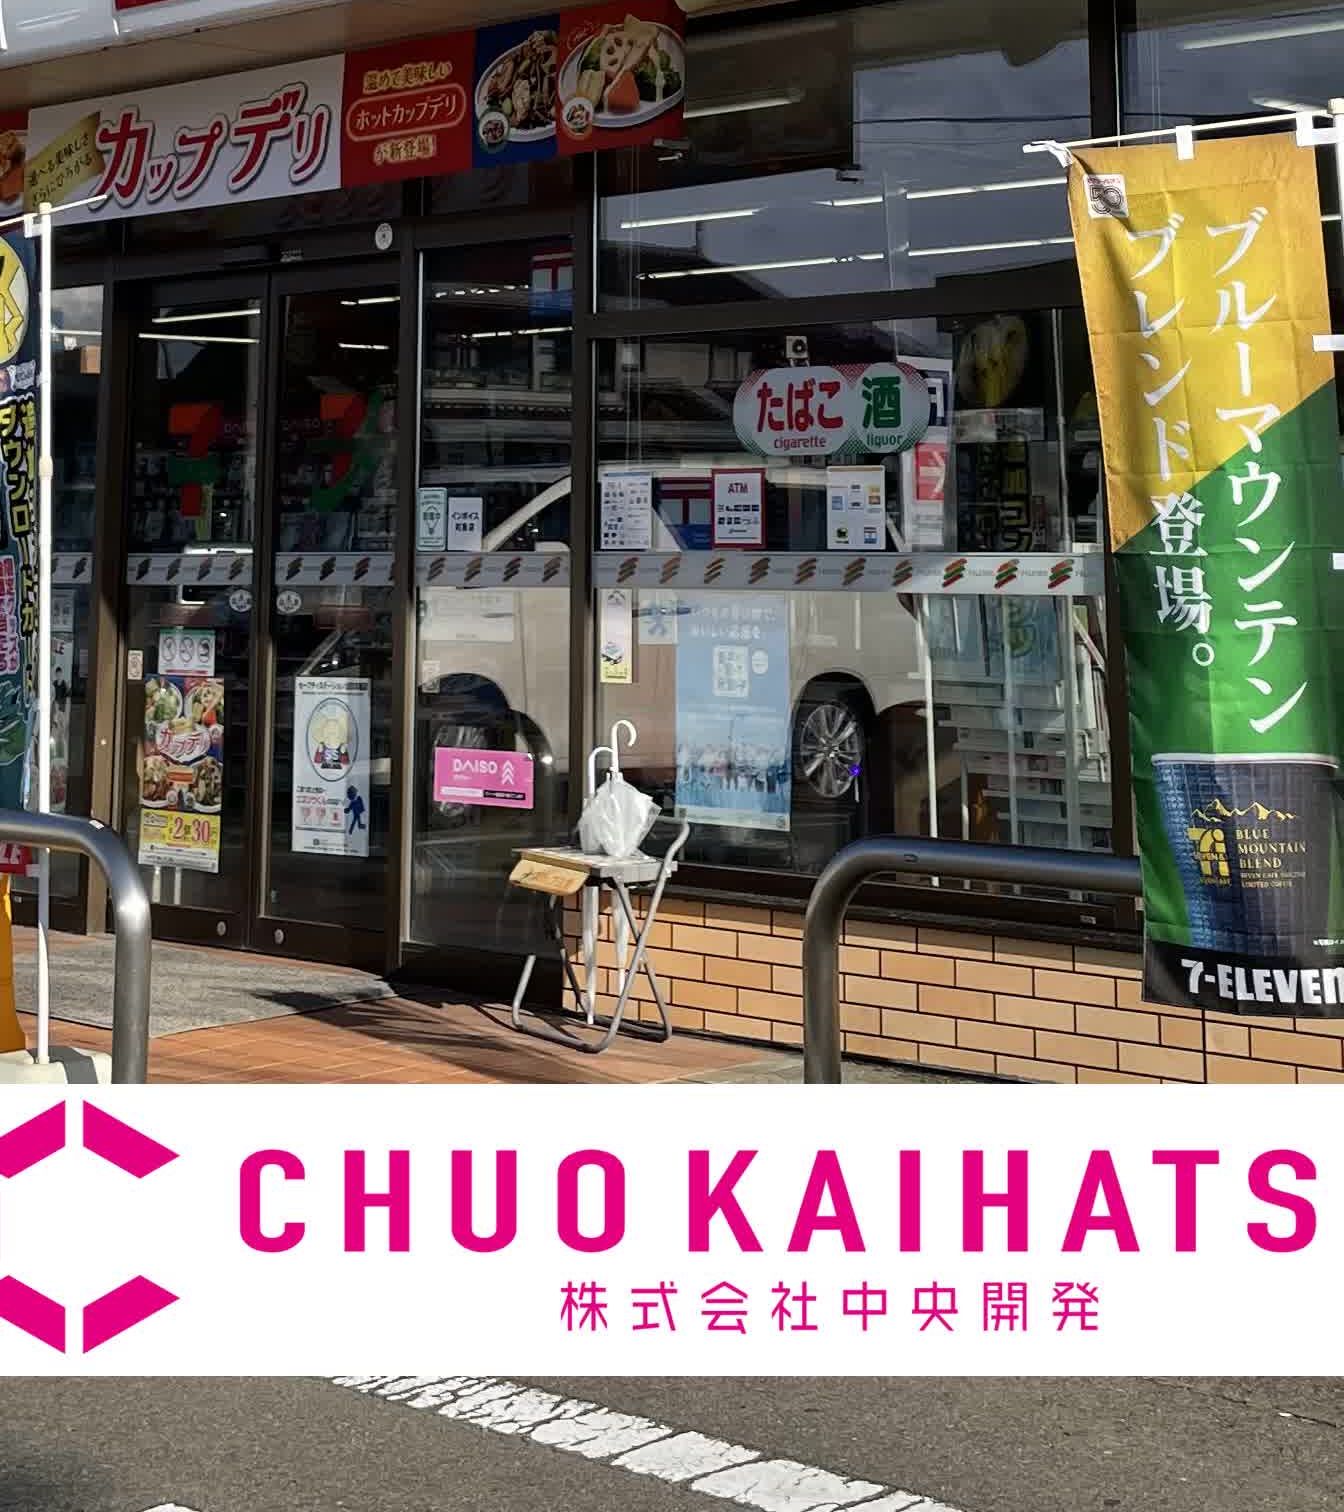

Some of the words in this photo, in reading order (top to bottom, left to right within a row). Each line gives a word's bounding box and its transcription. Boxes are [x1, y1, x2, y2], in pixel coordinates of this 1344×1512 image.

[356, 93, 457, 130] ホットカップデリ
[93, 85, 327, 204] カップデリ
[757, 377, 844, 432] たばこ
[862, 376, 902, 428] 酒
[773, 436, 827, 451] cigarette
[867, 433, 904, 447] liquor
[1126, 213, 1216, 668] ブレンド登場。
[1206, 205, 1307, 735] ブルーマウンテン
[728, 483, 749, 494] ATM
[453, 758, 498, 774] DAISO
[1236, 829, 1270, 840] BLUE
[1238, 841, 1307, 854] MOUNTAIN
[1240, 857, 1282, 869] BLEND
